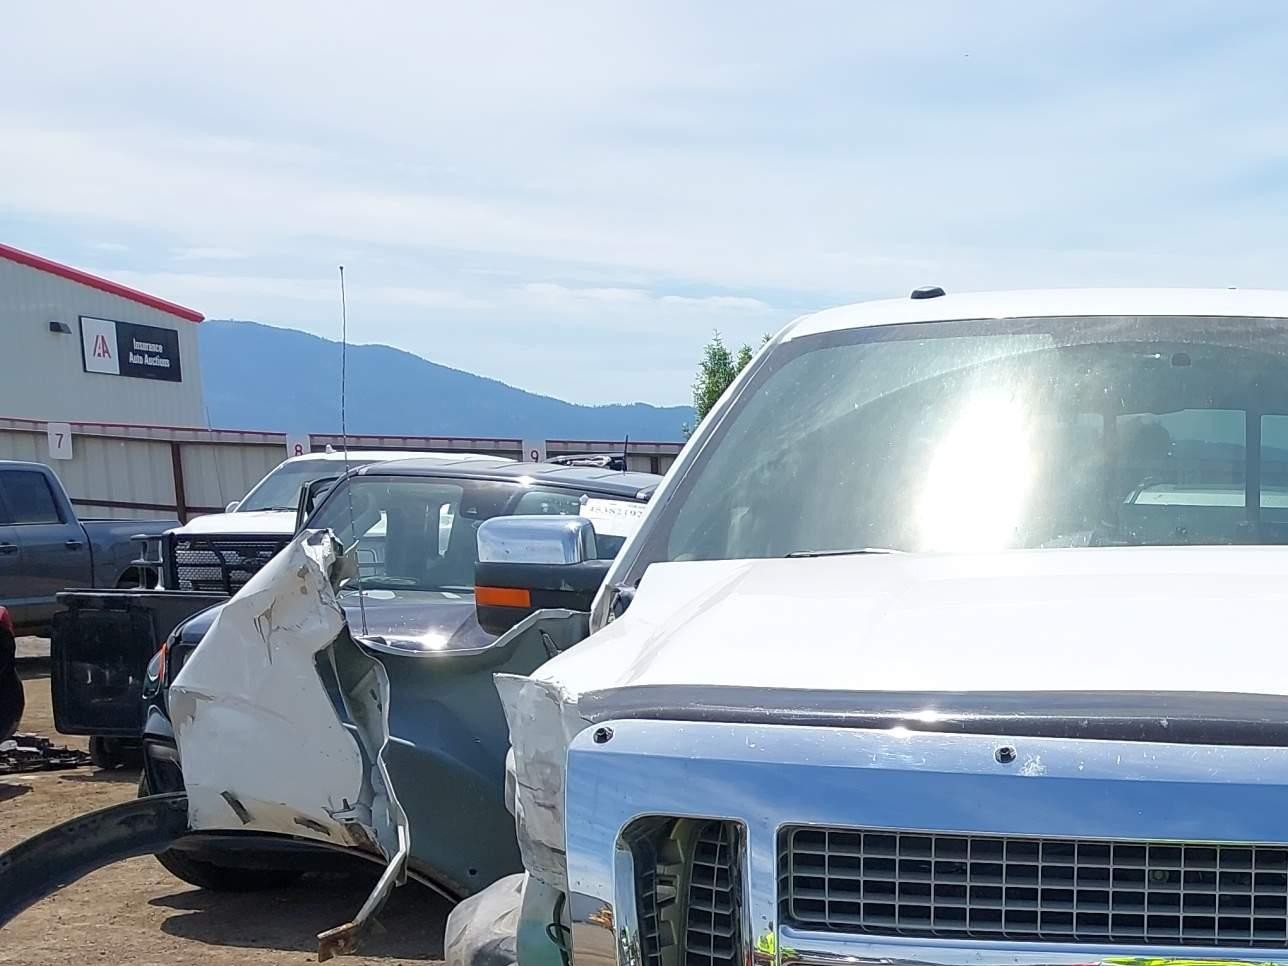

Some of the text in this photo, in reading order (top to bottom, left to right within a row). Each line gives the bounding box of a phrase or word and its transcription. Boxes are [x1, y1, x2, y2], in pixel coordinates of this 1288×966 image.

[132, 338, 163, 353] Insurance
[129, 352, 170, 367] Auto Auctions
[55, 433, 64, 448] 7
[295, 444, 304, 457] 8
[531, 450, 539, 463] 9
